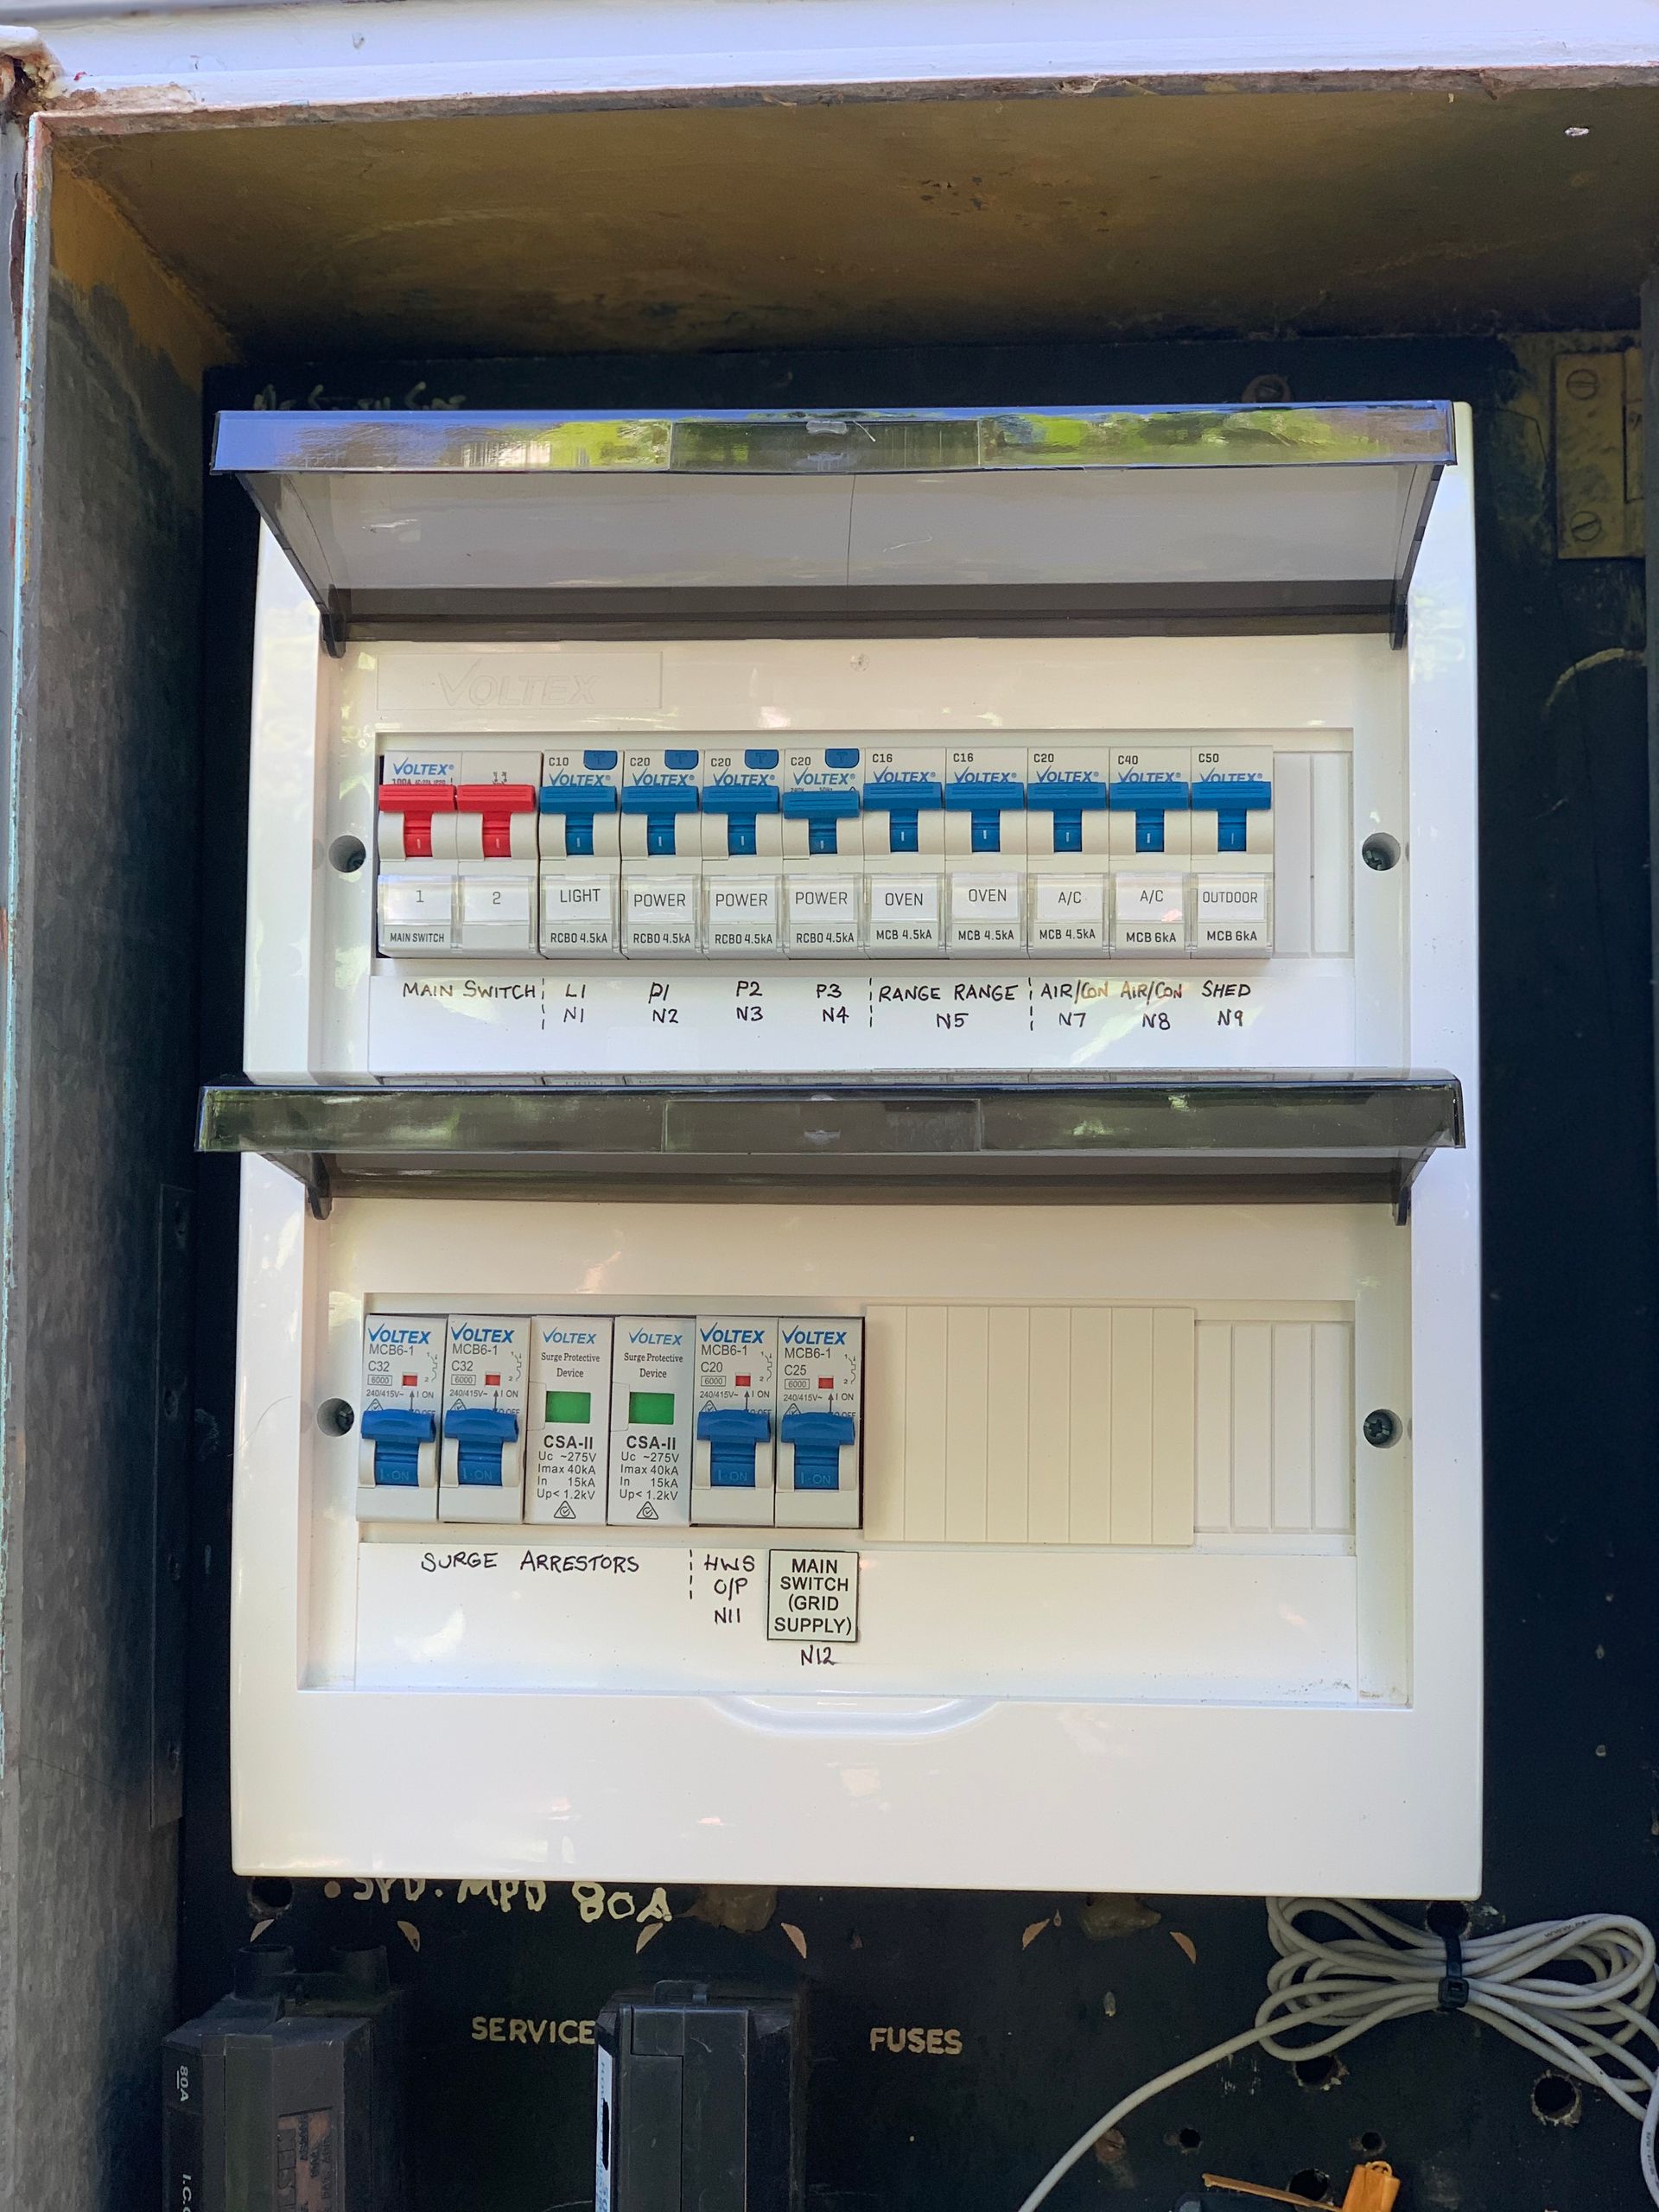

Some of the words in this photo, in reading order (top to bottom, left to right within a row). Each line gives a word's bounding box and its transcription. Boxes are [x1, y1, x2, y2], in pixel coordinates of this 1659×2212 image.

[438, 658, 601, 706] VOLTEX
[549, 757, 569, 766] C10
[630, 757, 651, 766] C20
[711, 758, 731, 766] C20
[791, 757, 811, 766] C20
[872, 754, 893, 763] C16
[953, 753, 974, 762] C16
[1033, 753, 1054, 763] C20
[1118, 755, 1138, 765] C40
[1198, 753, 1219, 763] C50
[393, 757, 448, 775] VOLTEX
[416, 890, 424, 903] 1
[493, 891, 501, 905] 2
[560, 889, 601, 903] LIGHT
[634, 893, 685, 907] POWER
[715, 893, 767, 906] POWER
[795, 892, 848, 905] POWER
[885, 893, 923, 906] OVEN
[969, 888, 1007, 902] OVEN
[1058, 891, 1082, 905] A/C
[1140, 889, 1164, 903] A/C
[1203, 891, 1258, 904] OUTDOOR
[390, 933, 411, 943] MAIN
[412, 933, 444, 943] SWITCH
[550, 933, 578, 944] RCBO
[580, 933, 607, 944] 4.5kA
[633, 933, 661, 944] RCBO
[663, 933, 690, 944] 4.5kA
[715, 933, 742, 944] RCBO
[744, 933, 772, 944] 4.5kA
[796, 932, 823, 944] RCBO
[826, 932, 855, 944] 4.5kA
[876, 929, 899, 940] MCB
[902, 929, 932, 940] 4.5kA
[958, 930, 981, 941] MCB
[984, 930, 1014, 941] 4.5kA
[1039, 929, 1062, 940] MCB
[1065, 929, 1096, 940] 4.5kA
[1126, 931, 1152, 943] MCB
[1154, 931, 1177, 943] 6kA
[1206, 931, 1233, 942] MCB
[1235, 931, 1258, 942] 6kA
[402, 982, 454, 998] MAIN
[464, 980, 537, 1000] SWITCH
[736, 981, 763, 999] P2
[817, 983, 842, 999] P3
[879, 985, 941, 1002] RANGE
[953, 984, 1019, 1001] RANGE
[1040, 982, 1109, 1003] AIR/CON
[1202, 980, 1251, 998] SHED
[563, 1007, 585, 1023] N1
[653, 1007, 678, 1024] N2
[737, 1006, 764, 1021] N3
[823, 1007, 849, 1024] N4
[1058, 1013, 1086, 1027] N7
[1217, 1010, 1243, 1027] N9
[937, 1013, 969, 1029] N5
[1142, 1013, 1171, 1031] N8
[367, 1322, 431, 1344] VOLTEX
[451, 1322, 515, 1344] VOLTEX
[543, 1326, 596, 1344] VOLTEX
[628, 1327, 683, 1345] VOLTEX
[700, 1322, 765, 1344] VOLTEX
[782, 1325, 847, 1345] VOLTEX
[369, 1344, 414, 1356] MCB6-1
[452, 1344, 498, 1356] MCB6-1
[701, 1344, 747, 1356] MCB6-1
[785, 1347, 831, 1359] MCB6-1
[541, 1352, 563, 1363] Surge
[563, 1353, 601, 1363] Protective
[624, 1352, 645, 1363] Surge
[646, 1353, 683, 1363] Protective
[368, 1361, 390, 1372] C32
[451, 1361, 474, 1371] C32
[700, 1362, 723, 1373] C20
[784, 1364, 807, 1376] C25
[556, 1368, 584, 1378] Device
[639, 1368, 667, 1378] Device
[422, 1390, 434, 1399] ON
[505, 1389, 518, 1398] ON
[841, 1393, 854, 1402] ON
[543, 1435, 593, 1449] CSA-II
[626, 1435, 676, 1450] CSA-II
[538, 1451, 553, 1461] Uc
[620, 1452, 636, 1462] Uc
[537, 1463, 564, 1474] Imax
[567, 1465, 596, 1475] 40kA
[620, 1465, 647, 1475] Imax
[650, 1465, 679, 1476] 40kA
[537, 1476, 547, 1486] In
[568, 1477, 595, 1487] 15kA
[620, 1477, 630, 1486] In
[651, 1478, 678, 1488] 15kA
[563, 1489, 595, 1500] 1.2kV
[646, 1491, 678, 1501] 1.2kV
[421, 1552, 498, 1572] SURGE
[519, 1549, 639, 1573] ARRESTORS
[703, 1554, 755, 1573] HWS
[791, 1559, 837, 1574] MAIN
[714, 1579, 747, 1601] O/P
[780, 1575, 849, 1592] SWITCH
[788, 1595, 839, 1612] (GRID
[774, 1617, 852, 1636] SUPPLY)
[800, 1645, 836, 1666] N12
[571, 1881, 672, 1923] 80A
[471, 2016, 595, 2045] SERVICE
[870, 2025, 963, 2055] FUSES
[180, 2065, 189, 2102] 80A
